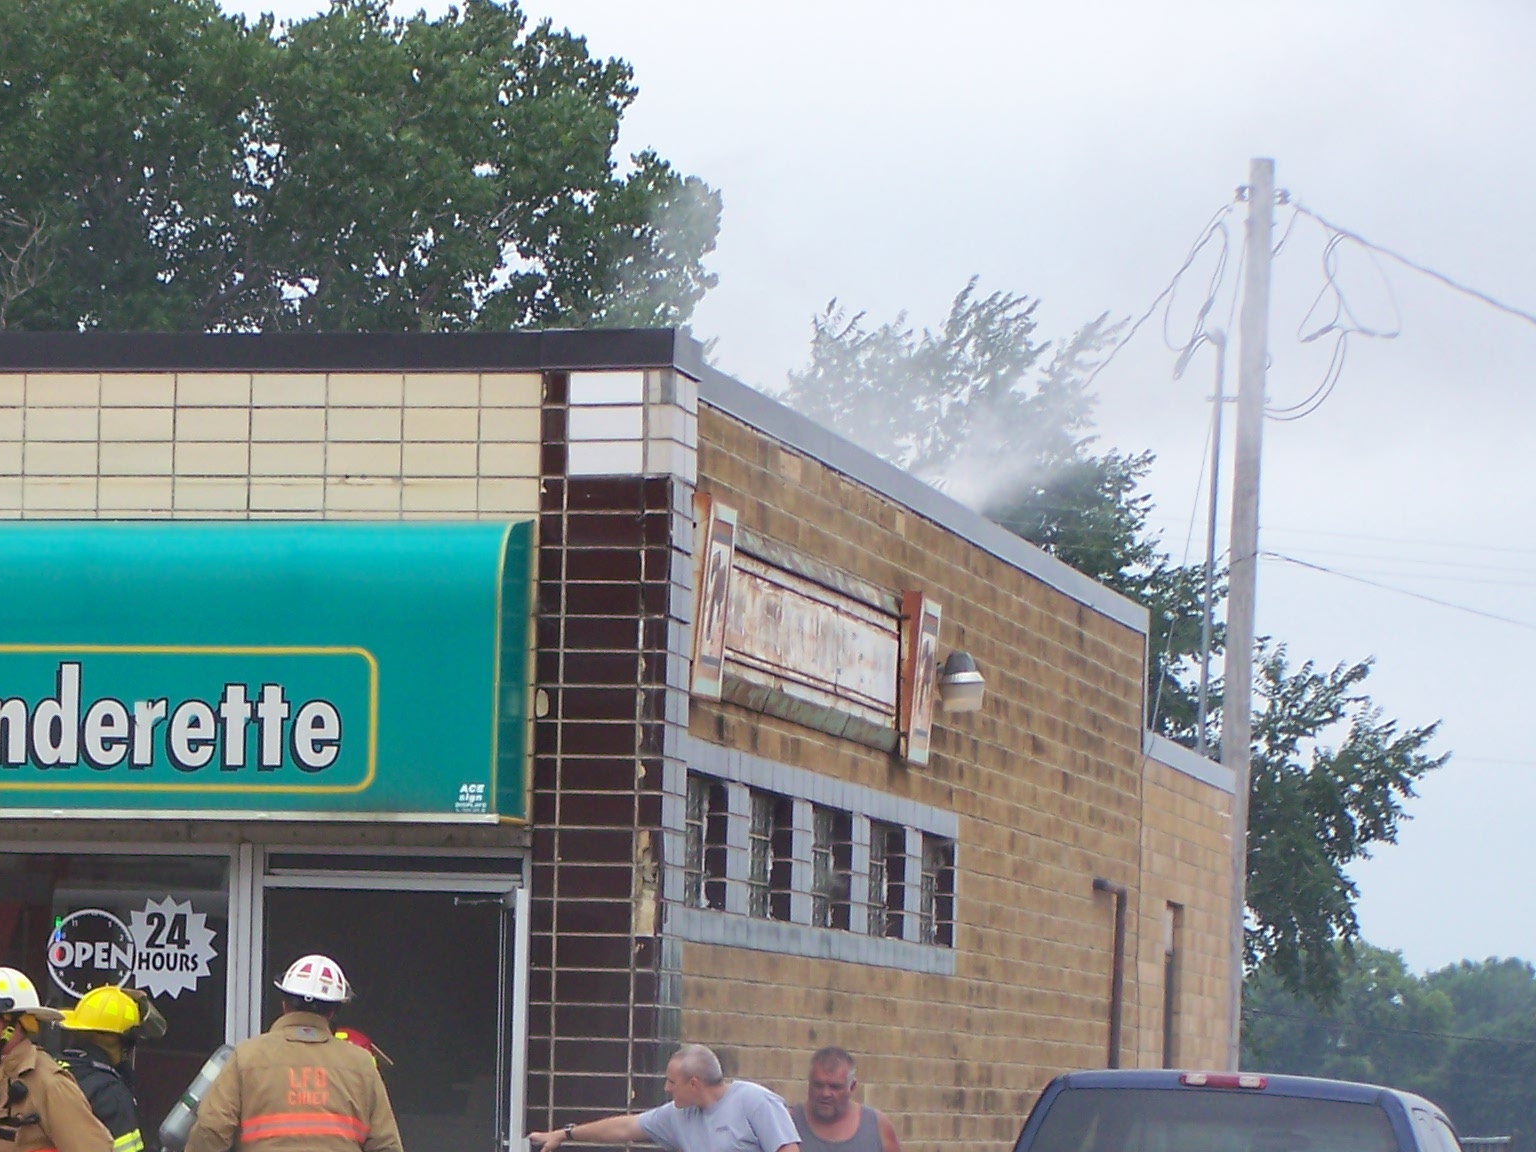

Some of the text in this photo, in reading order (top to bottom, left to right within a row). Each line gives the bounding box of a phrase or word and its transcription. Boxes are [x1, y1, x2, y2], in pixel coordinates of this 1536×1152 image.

[459, 783, 485, 794] ACE
[145, 911, 191, 950] 24
[48, 940, 134, 970] OPEN
[137, 951, 199, 973] HOURS
